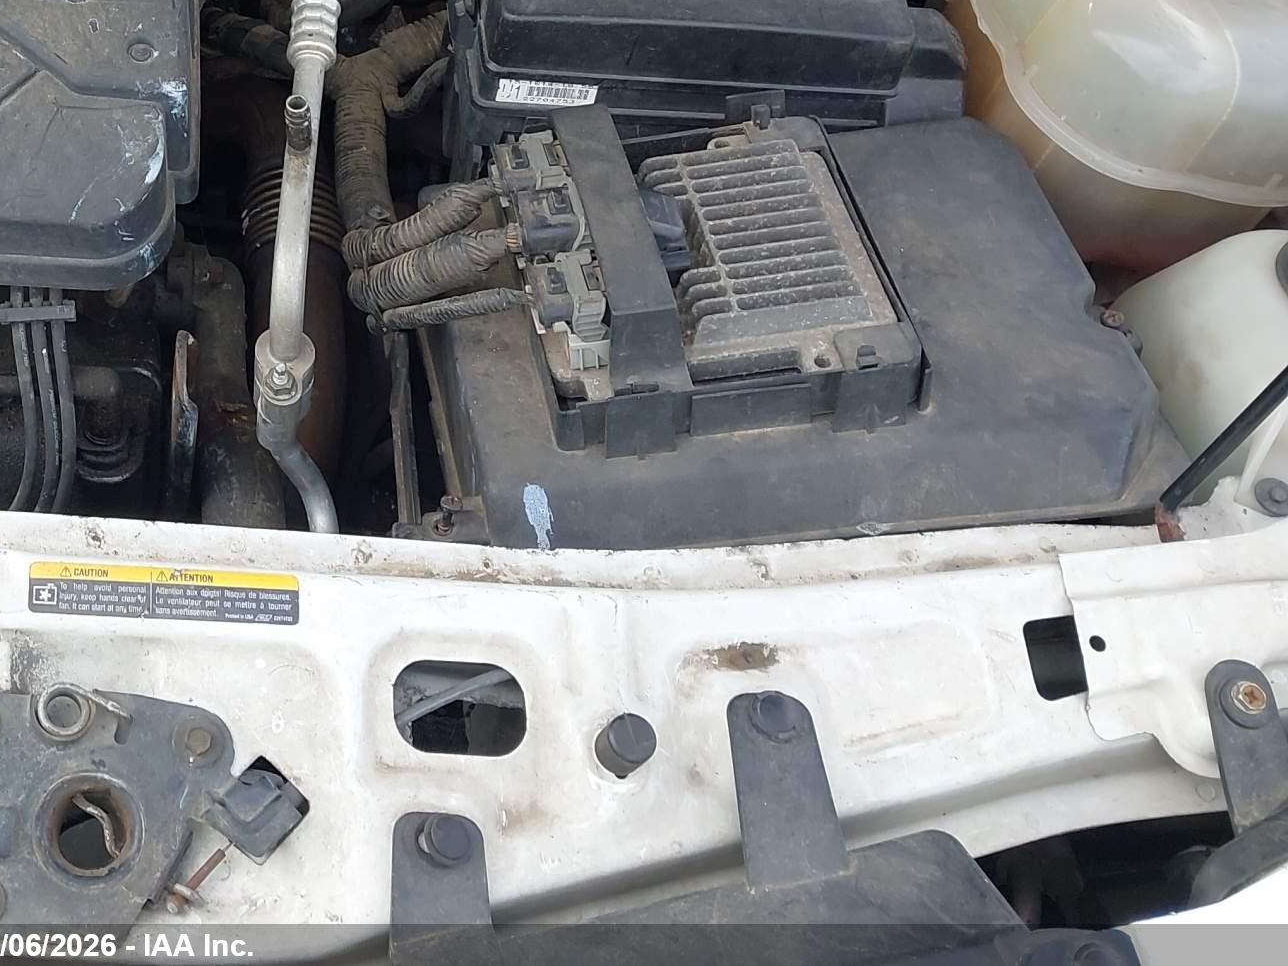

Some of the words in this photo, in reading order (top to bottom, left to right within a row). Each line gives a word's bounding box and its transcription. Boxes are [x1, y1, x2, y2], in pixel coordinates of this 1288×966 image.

[73, 568, 108, 577] CAUTION
[73, 582, 87, 591] help
[94, 583, 111, 592] avoid
[118, 584, 146, 594] personal
[80, 593, 96, 601] keep
[99, 594, 118, 602] hands
[121, 595, 136, 603] clear
[224, 589, 245, 598] Risque
[78, 602, 89, 611] can
[91, 603, 105, 611] start
[205, 599, 219, 607] peut
[235, 600, 256, 609] mettre
[268, 602, 291, 611] tourner
